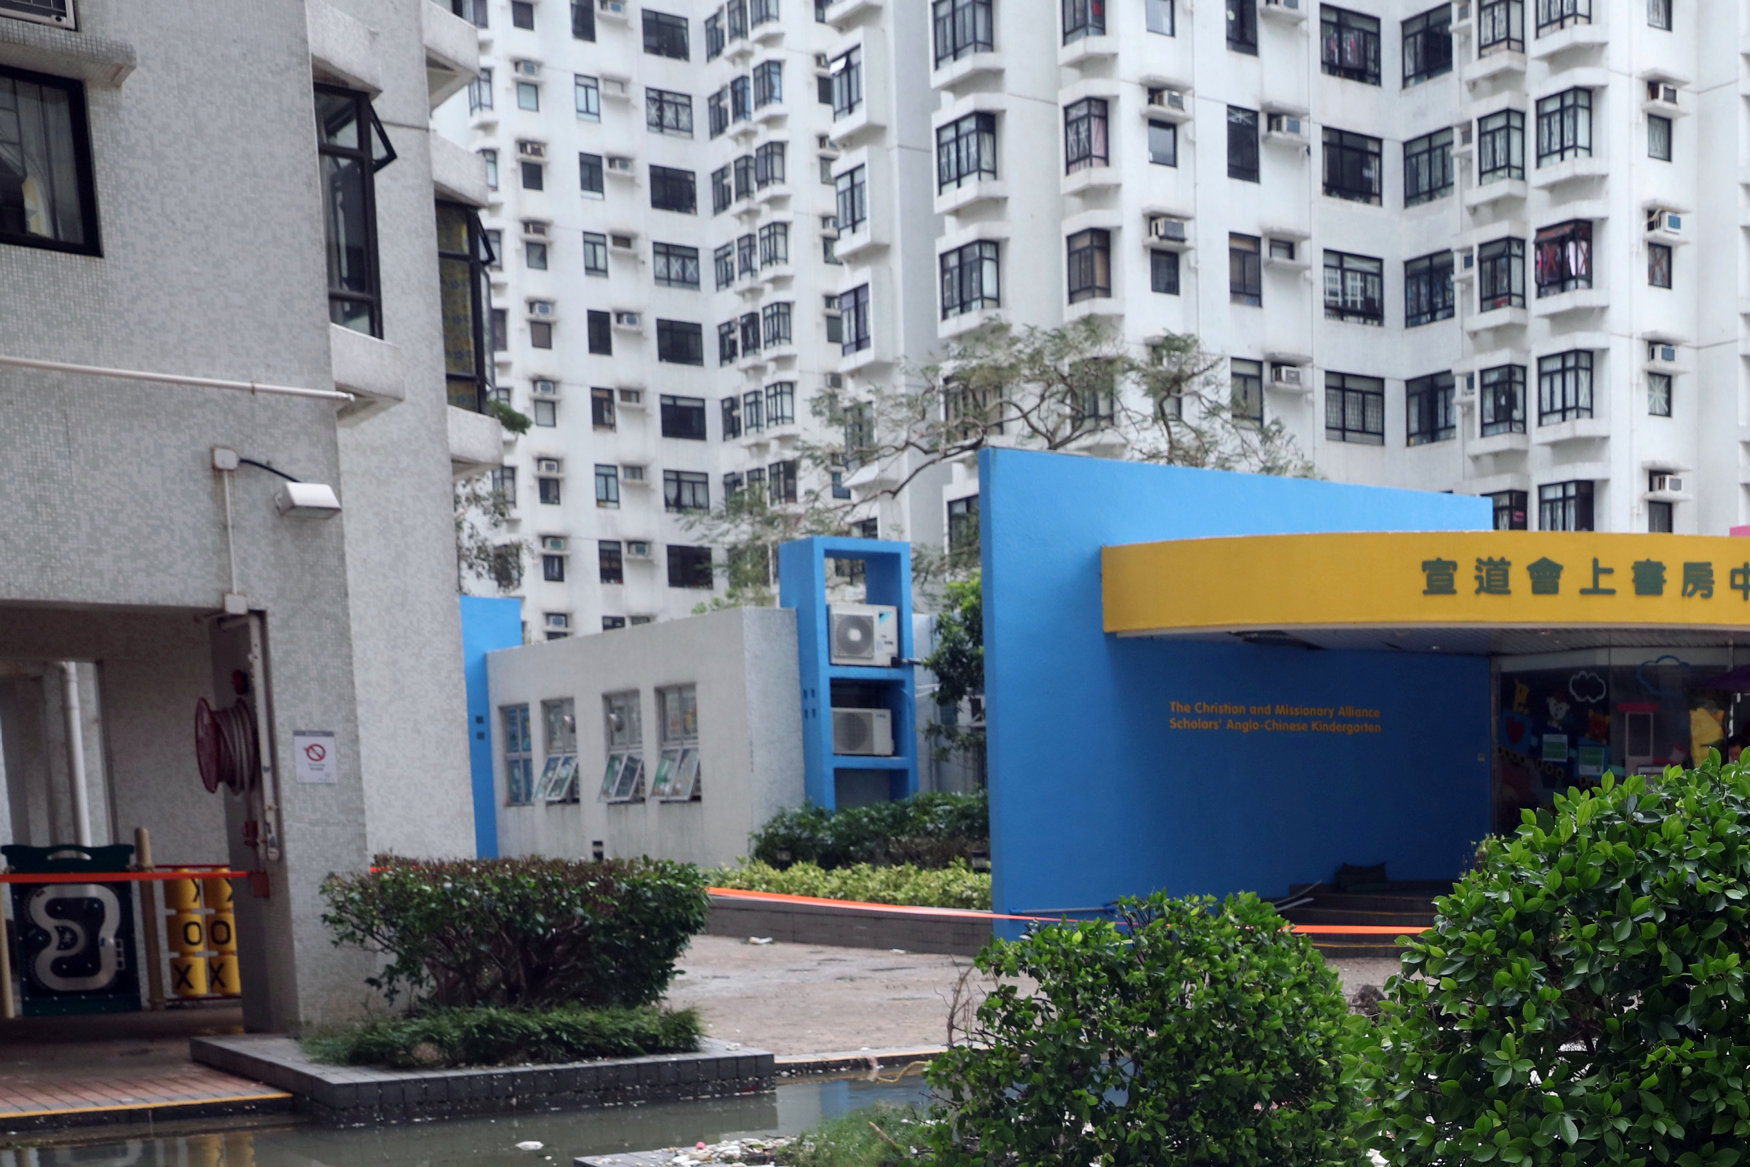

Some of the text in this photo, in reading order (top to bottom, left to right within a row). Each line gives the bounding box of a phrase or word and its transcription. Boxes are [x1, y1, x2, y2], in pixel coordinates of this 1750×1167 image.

[1169, 701, 1381, 719] The Christian and Missionary Alliance
[1169, 717, 1382, 735] Scholars' Anglo-Chinese Kindergarten
